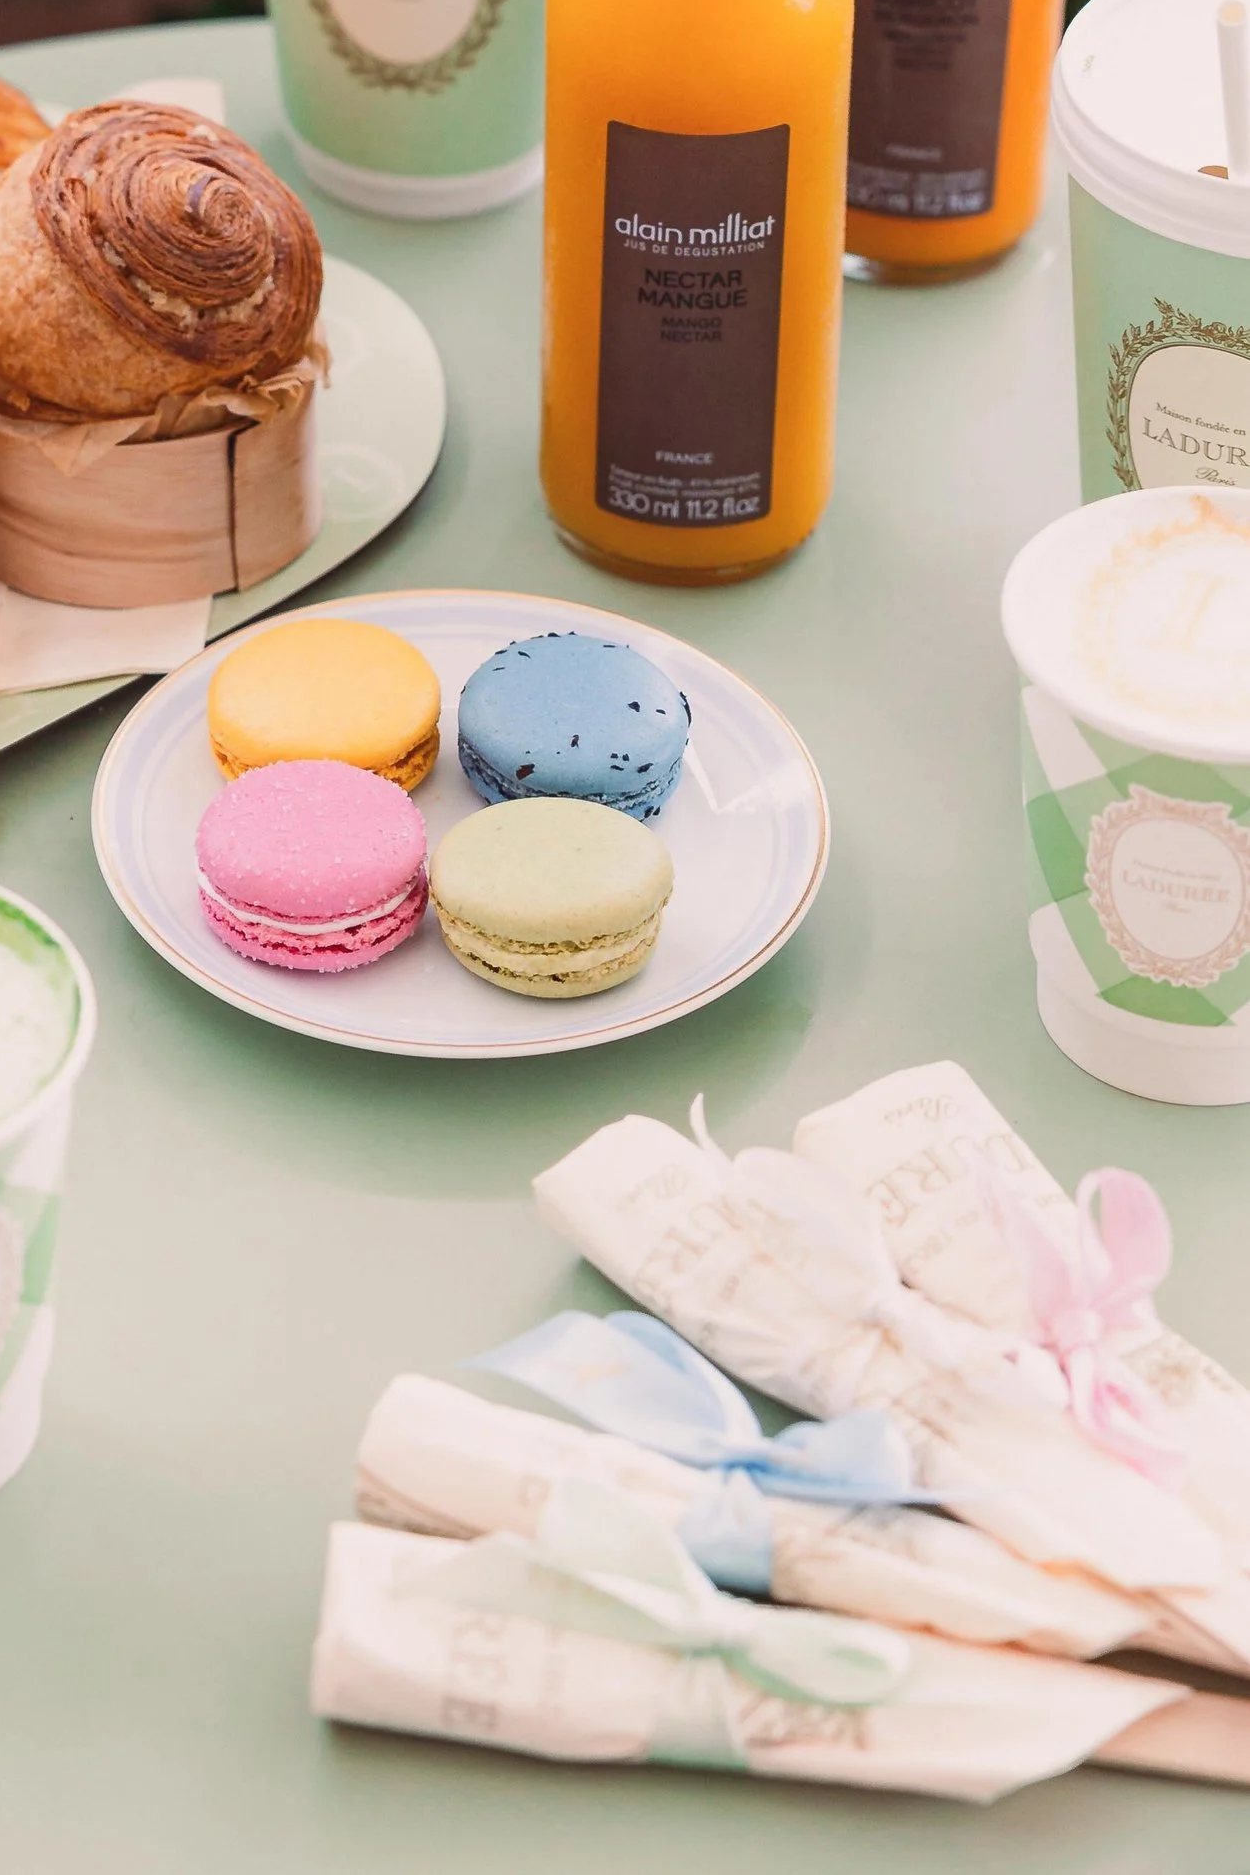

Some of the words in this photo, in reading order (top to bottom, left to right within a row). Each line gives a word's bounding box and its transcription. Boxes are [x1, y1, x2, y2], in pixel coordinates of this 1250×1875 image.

[615, 213, 683, 245] alain
[688, 212, 776, 246] milliat
[623, 238, 647, 252] JUS
[652, 243, 669, 256] DE
[674, 240, 766, 257] DEGUSTATION
[644, 267, 743, 290] NECTAR
[637, 286, 749, 310] MANGUE
[660, 315, 723, 330] MANGO
[660, 328, 723, 344] NECTAR
[1155, 402, 1193, 424] Maison
[1195, 417, 1231, 434] fondée
[1233, 428, 1247, 436] en
[654, 450, 715, 466] FRANCE
[1195, 466, 1237, 487] Paris
[608, 485, 651, 515] 330
